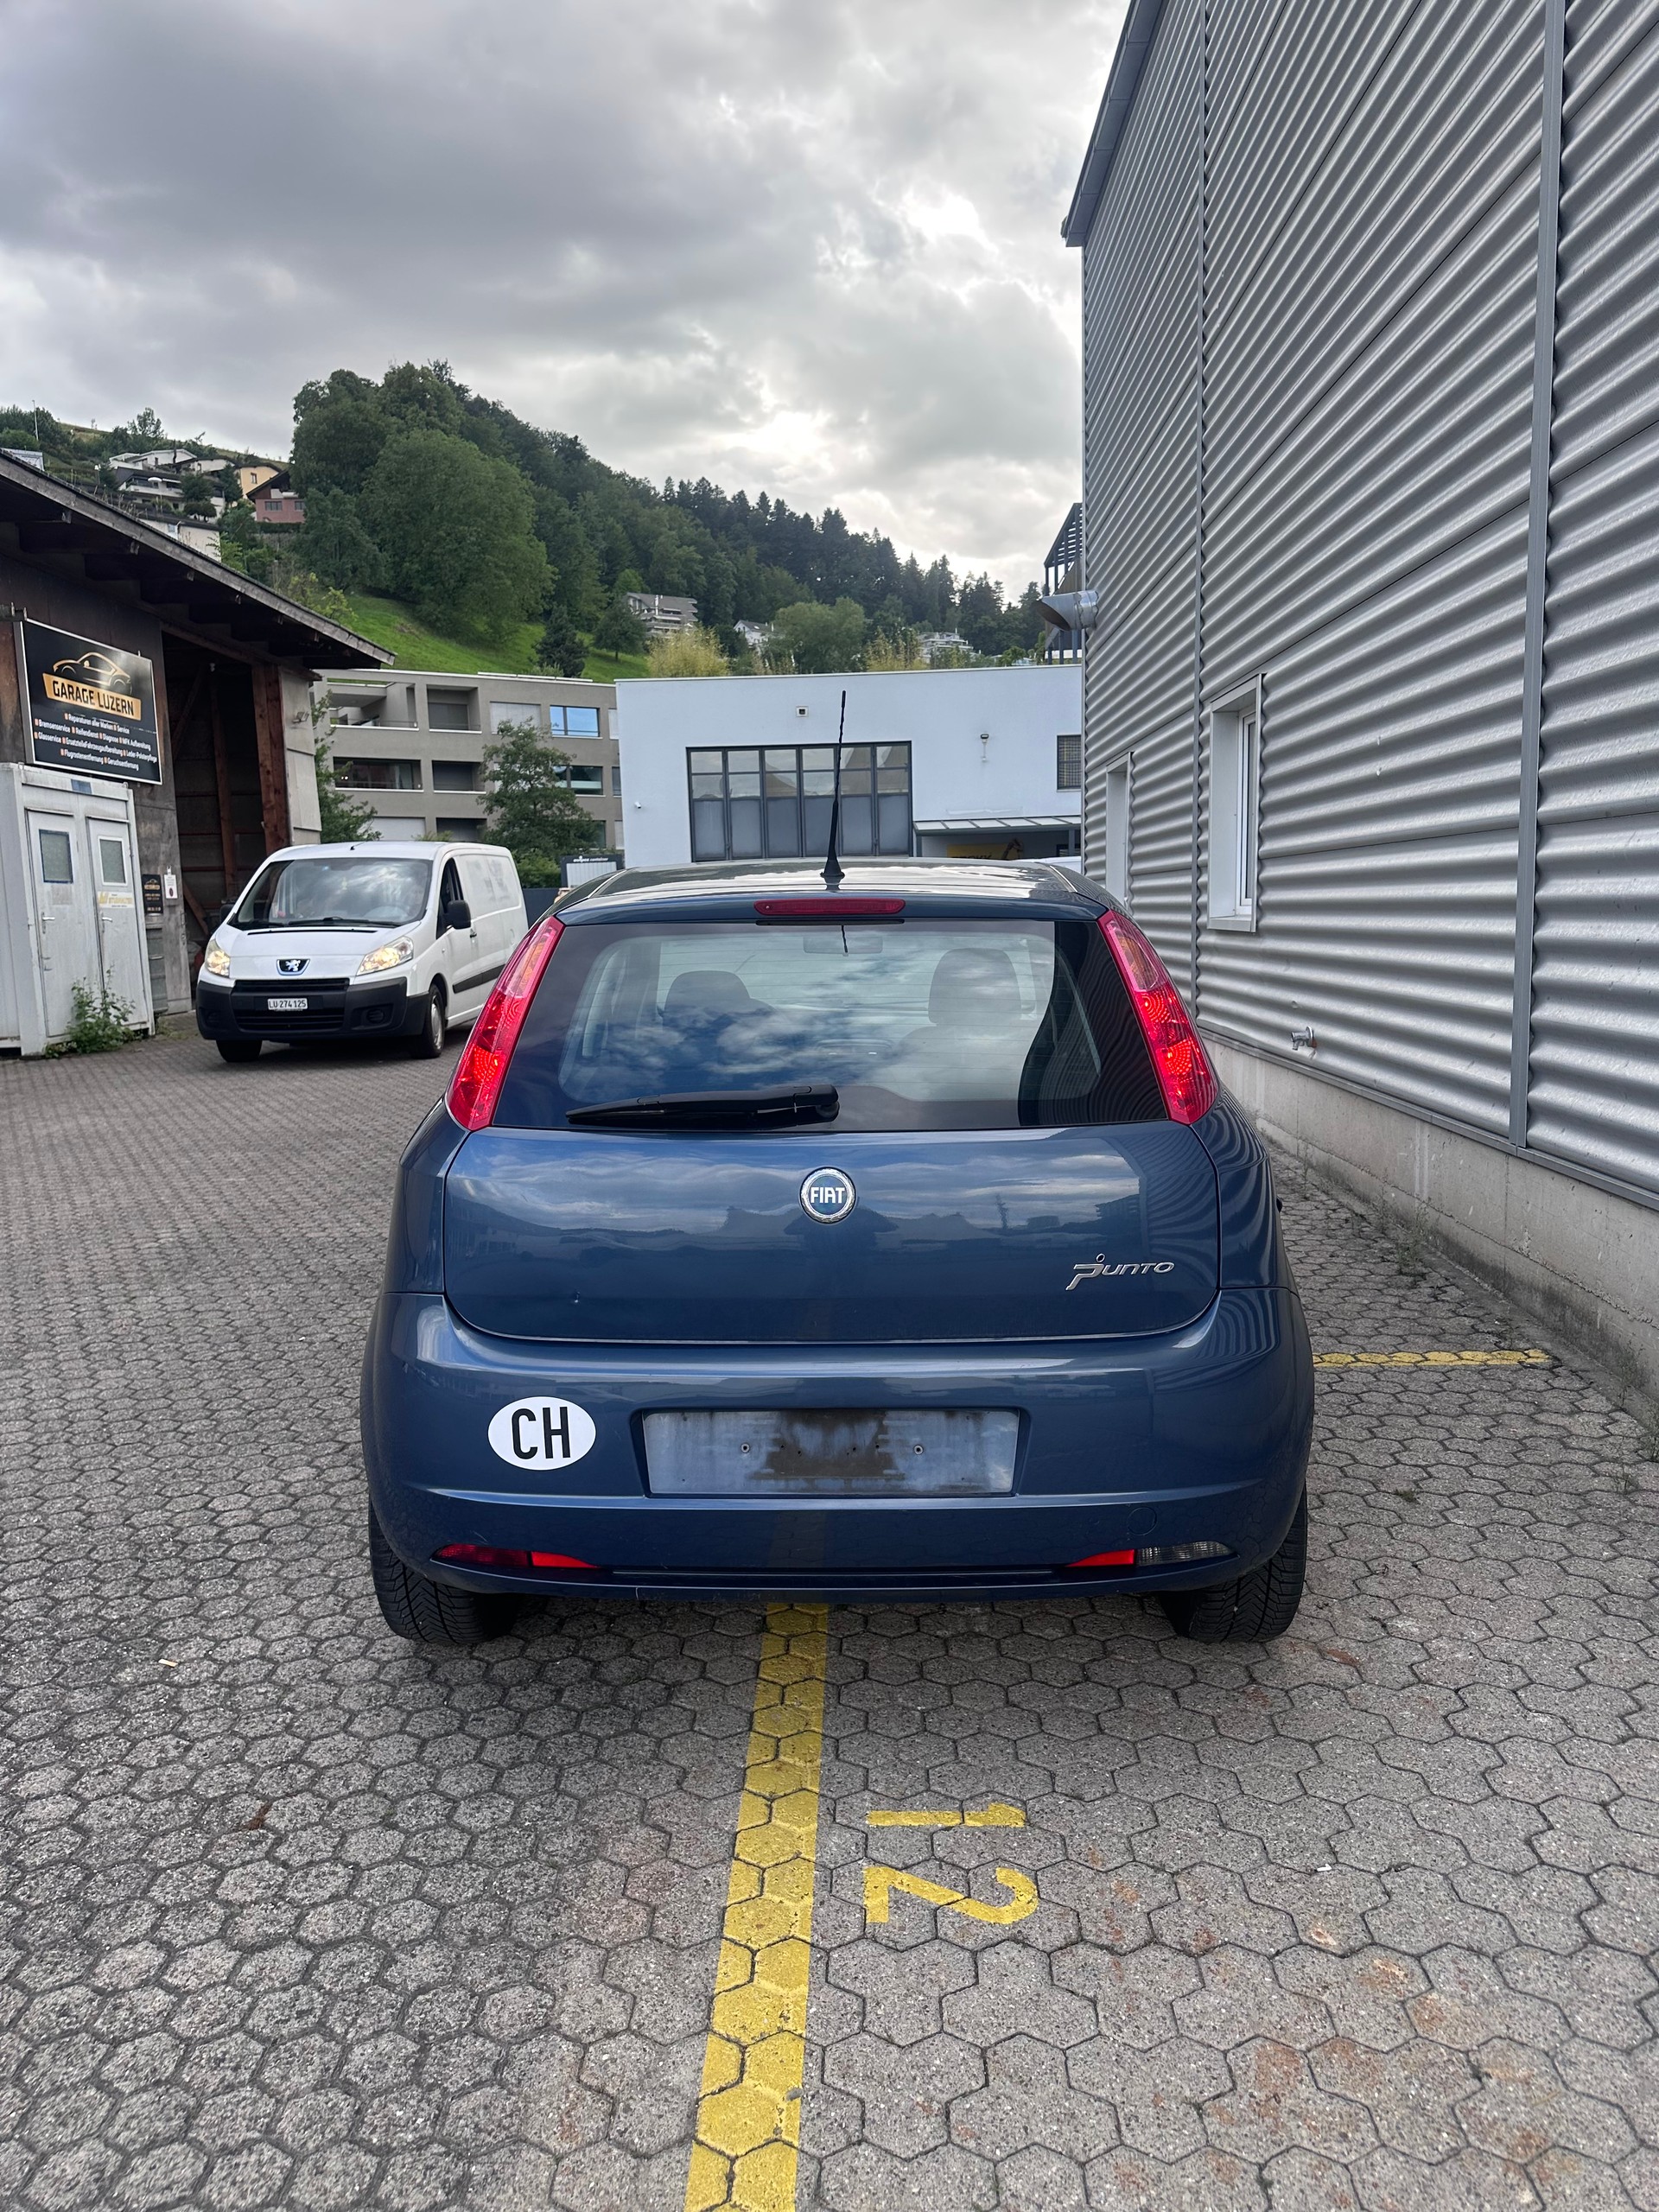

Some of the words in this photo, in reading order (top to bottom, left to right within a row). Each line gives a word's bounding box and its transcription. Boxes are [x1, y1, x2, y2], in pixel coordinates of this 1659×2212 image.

[53, 680, 95, 705] GARAGE
[98, 692, 134, 716] LUZERN
[38, 731, 61, 744] Glasservice
[39, 718, 70, 734] Bremsenservice
[76, 727, 99, 739] Reifendienst
[103, 733, 118, 744] Diagnose
[118, 725, 130, 734] Service
[269, 1000, 277, 1008] LU
[810, 1186, 845, 1204] FIAT
[512, 1407, 571, 1459] CH
[867, 1802, 1038, 1924] 12
